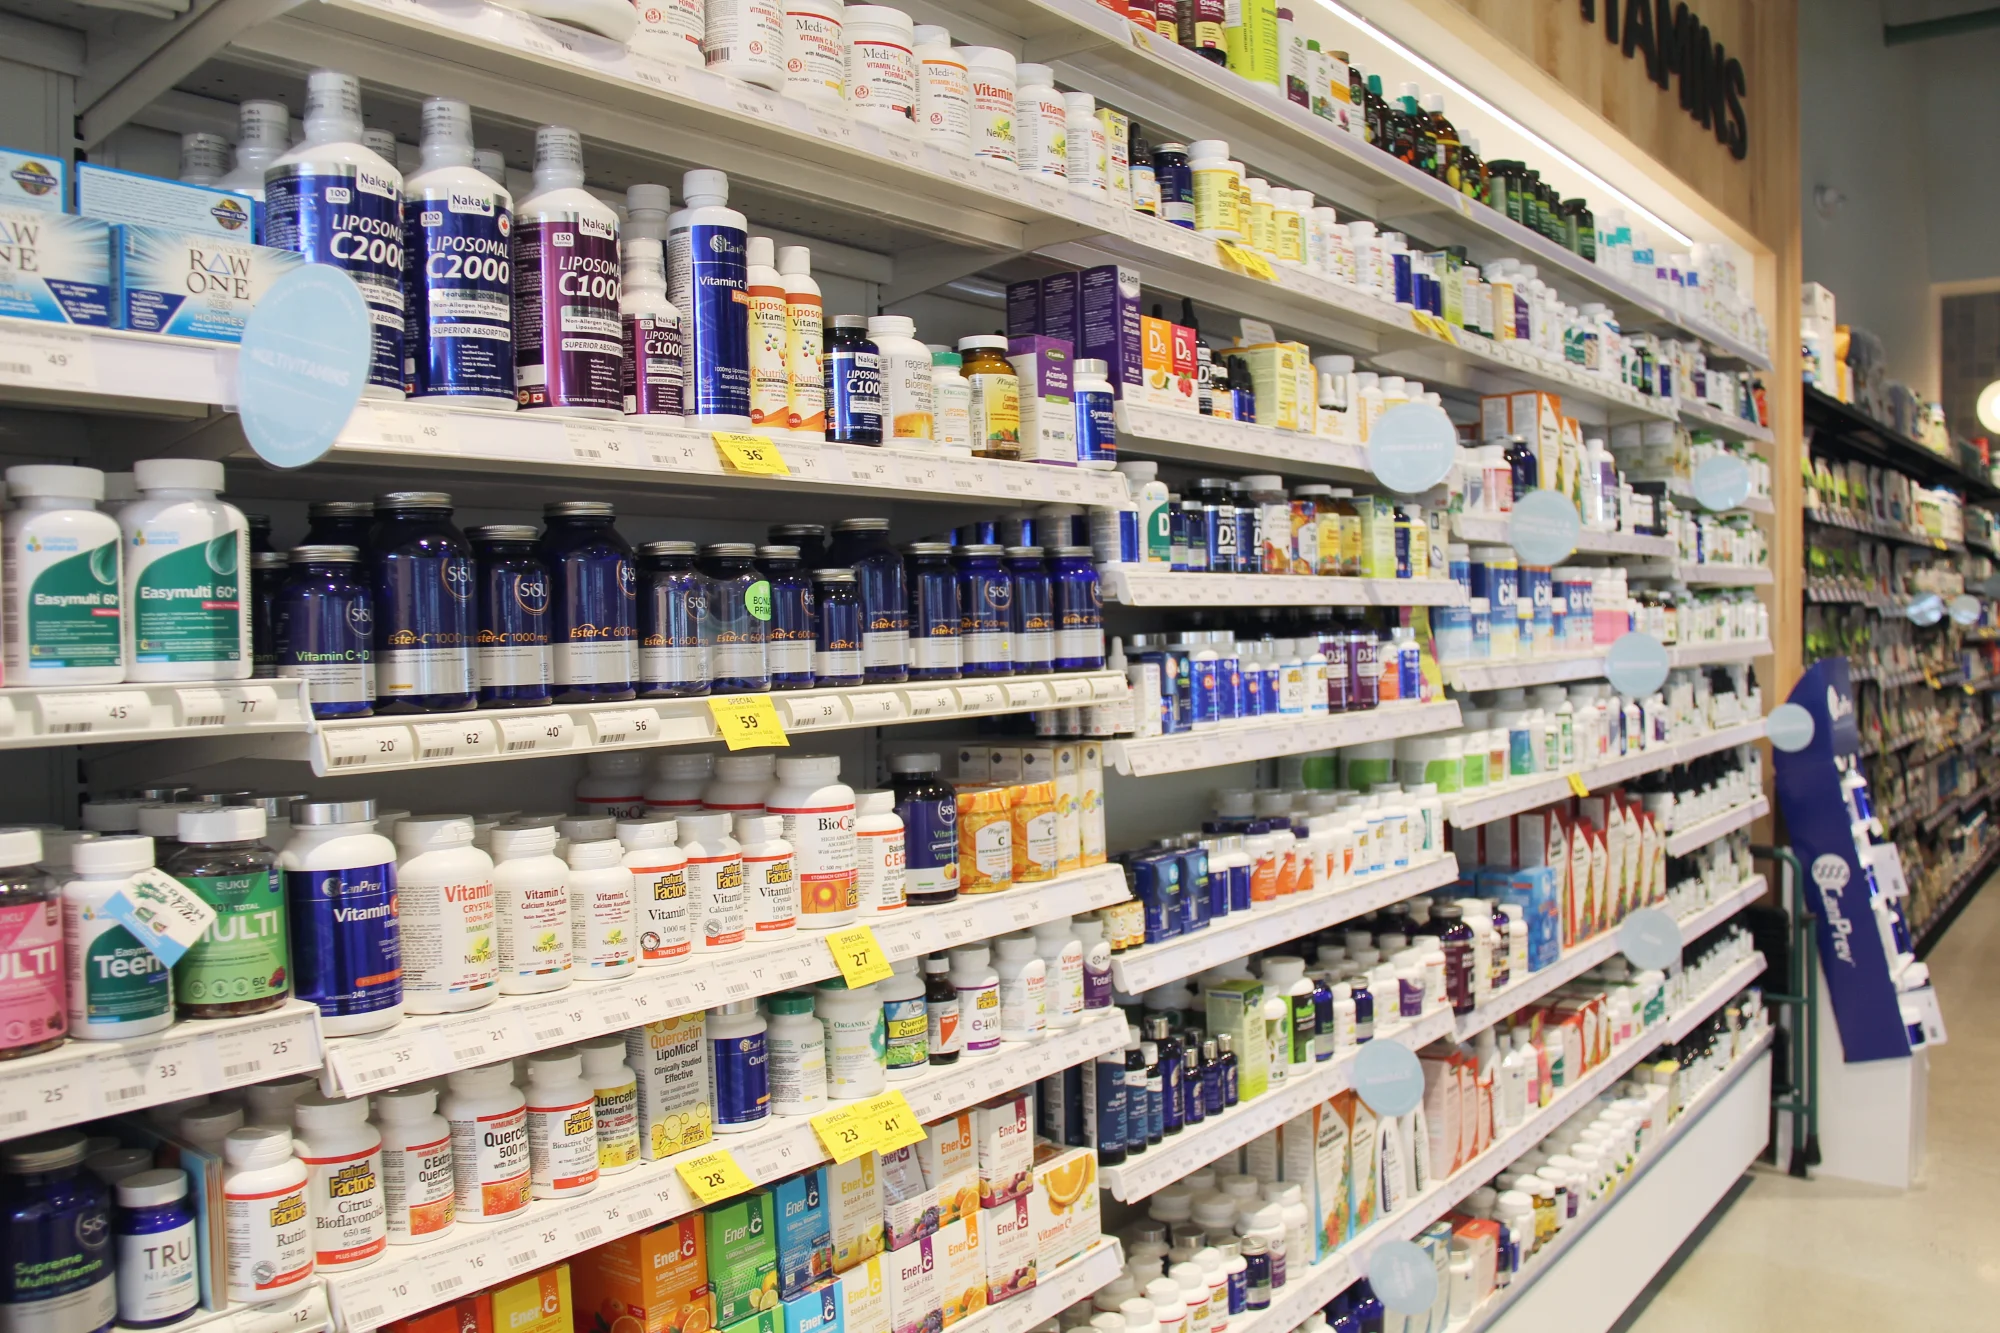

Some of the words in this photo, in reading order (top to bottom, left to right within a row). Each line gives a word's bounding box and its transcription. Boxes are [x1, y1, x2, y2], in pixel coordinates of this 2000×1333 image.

[796, 19, 822, 32] Medi
[800, 34, 823, 45] VITAMIN
[817, 44, 839, 56] FORMULA
[863, 48, 889, 60] Medi
[867, 62, 890, 72] VITAMIN
[928, 67, 950, 78] Medi
[884, 71, 907, 82] FORMULA
[973, 83, 1013, 101] Vitamin
[361, 173, 387, 188] Naka
[329, 189, 347, 198] 100
[452, 193, 480, 206] Naka
[423, 212, 440, 221] 100
[332, 214, 404, 245] LIPOSOMA
[582, 217, 605, 231] Naka
[556, 234, 571, 242] 150
[430, 236, 509, 260] LIPOSOMAL
[189, 249, 250, 278] RAW
[426, 252, 510, 284] C2000
[559, 256, 621, 280] LIPOSOMA
[187, 272, 250, 300] ONE
[700, 276, 737, 289] Vitamin
[207, 300, 232, 310] MEN
[195, 313, 244, 327] HOMMES
[755, 312, 785, 322] Vitamin
[793, 318, 822, 329] Vitamin
[433, 326, 471, 335] SUPERIOR
[473, 327, 509, 338] ABSORPTION
[564, 341, 598, 350] SUPERIOR
[1149, 330, 1166, 355] D3
[1175, 337, 1191, 362] D3
[858, 355, 873, 364] Naka
[1045, 370, 1068, 381] Acerola
[1046, 379, 1068, 389] Powder
[729, 434, 757, 442] SPECIAL
[141, 583, 212, 600] Easymulti
[35, 593, 100, 607] Easymulti
[871, 617, 896, 629] Ester-C
[388, 630, 430, 645] Ester-C
[435, 633, 462, 643] 1000
[511, 632, 535, 642] 1000
[570, 624, 610, 638] Ester-C
[613, 627, 631, 637] 600
[717, 630, 747, 643] Ester-C
[644, 634, 675, 646] Ester-C
[296, 651, 344, 662] Vitamin
[772, 862, 790, 872] natural
[662, 872, 683, 885] natural
[767, 869, 792, 884] Factors
[216, 880, 250, 891] SUKU
[340, 880, 382, 896] CanPrev
[444, 880, 493, 903] Vitamin
[655, 883, 687, 901] Factors
[759, 885, 792, 898] Vitamin
[525, 888, 558, 900] Vitamin
[596, 892, 624, 902] Vitamin
[233, 903, 260, 912] TOTAL
[463, 902, 493, 914] CRYSTAL
[521, 901, 544, 910] Calcium
[772, 905, 785, 913] 1000
[334, 904, 390, 923] Vitamin
[465, 914, 482, 923] 100%
[649, 906, 686, 921] Vitamin
[203, 911, 278, 944] ULTI
[663, 925, 678, 934] 1000
[1823, 886, 1854, 966] CanPrev
[841, 933, 865, 944] SPECIAL
[532, 944, 548, 953] New
[657, 948, 675, 957] TIMED
[464, 953, 481, 965] New
[253, 977, 265, 986] 60
[352, 990, 366, 998] 240
[834, 1020, 870, 1029] ORGANIKA
[650, 1025, 702, 1050] Quercetin
[657, 1041, 699, 1062] LipoMicel
[654, 1062, 680, 1076] Clinically
[681, 1056, 702, 1069] Studied
[664, 1070, 693, 1084] Effective
[870, 1099, 894, 1112] SPECIAL
[571, 1107, 591, 1122] natural
[826, 1111, 850, 1125] SPECIAL
[490, 1119, 513, 1130] IMMUNE
[564, 1117, 594, 1135] Factors
[553, 1138, 582, 1150] Bioactive
[681, 1131, 705, 1145] Factors
[941, 1133, 971, 1155] Ener-C
[500, 1144, 516, 1158] 500
[494, 1160, 508, 1170] with
[509, 1159, 521, 1168] Zinc
[689, 1155, 717, 1169] SPECIAL
[339, 1161, 369, 1180] natural
[329, 1172, 376, 1199] Factors
[278, 1192, 303, 1209] natural
[786, 1191, 819, 1217] Ener-C
[844, 1189, 876, 1207] SUGAR-FREE
[338, 1199, 373, 1213] Citrus
[270, 1203, 307, 1227] Factors
[316, 1206, 384, 1229] Bioflavonoids
[276, 1229, 306, 1247] Rutin
[343, 1227, 359, 1238] 650
[360, 1227, 371, 1237] mg
[724, 1218, 762, 1245] Ener-C
[1038, 1224, 1063, 1242] Vitamin
[143, 1237, 191, 1270] TRU
[282, 1250, 294, 1260] 250
[653, 1239, 694, 1269] Ener-C
[15, 1253, 83, 1275] Supreme
[901, 1254, 933, 1281] Ener-C
[15, 1258, 104, 1289] Multivitamin
[143, 1262, 192, 1282] NIAGEN
[903, 1274, 934, 1293] SUGAR-FREE
[850, 1296, 882, 1316] SUGAR-FREE
